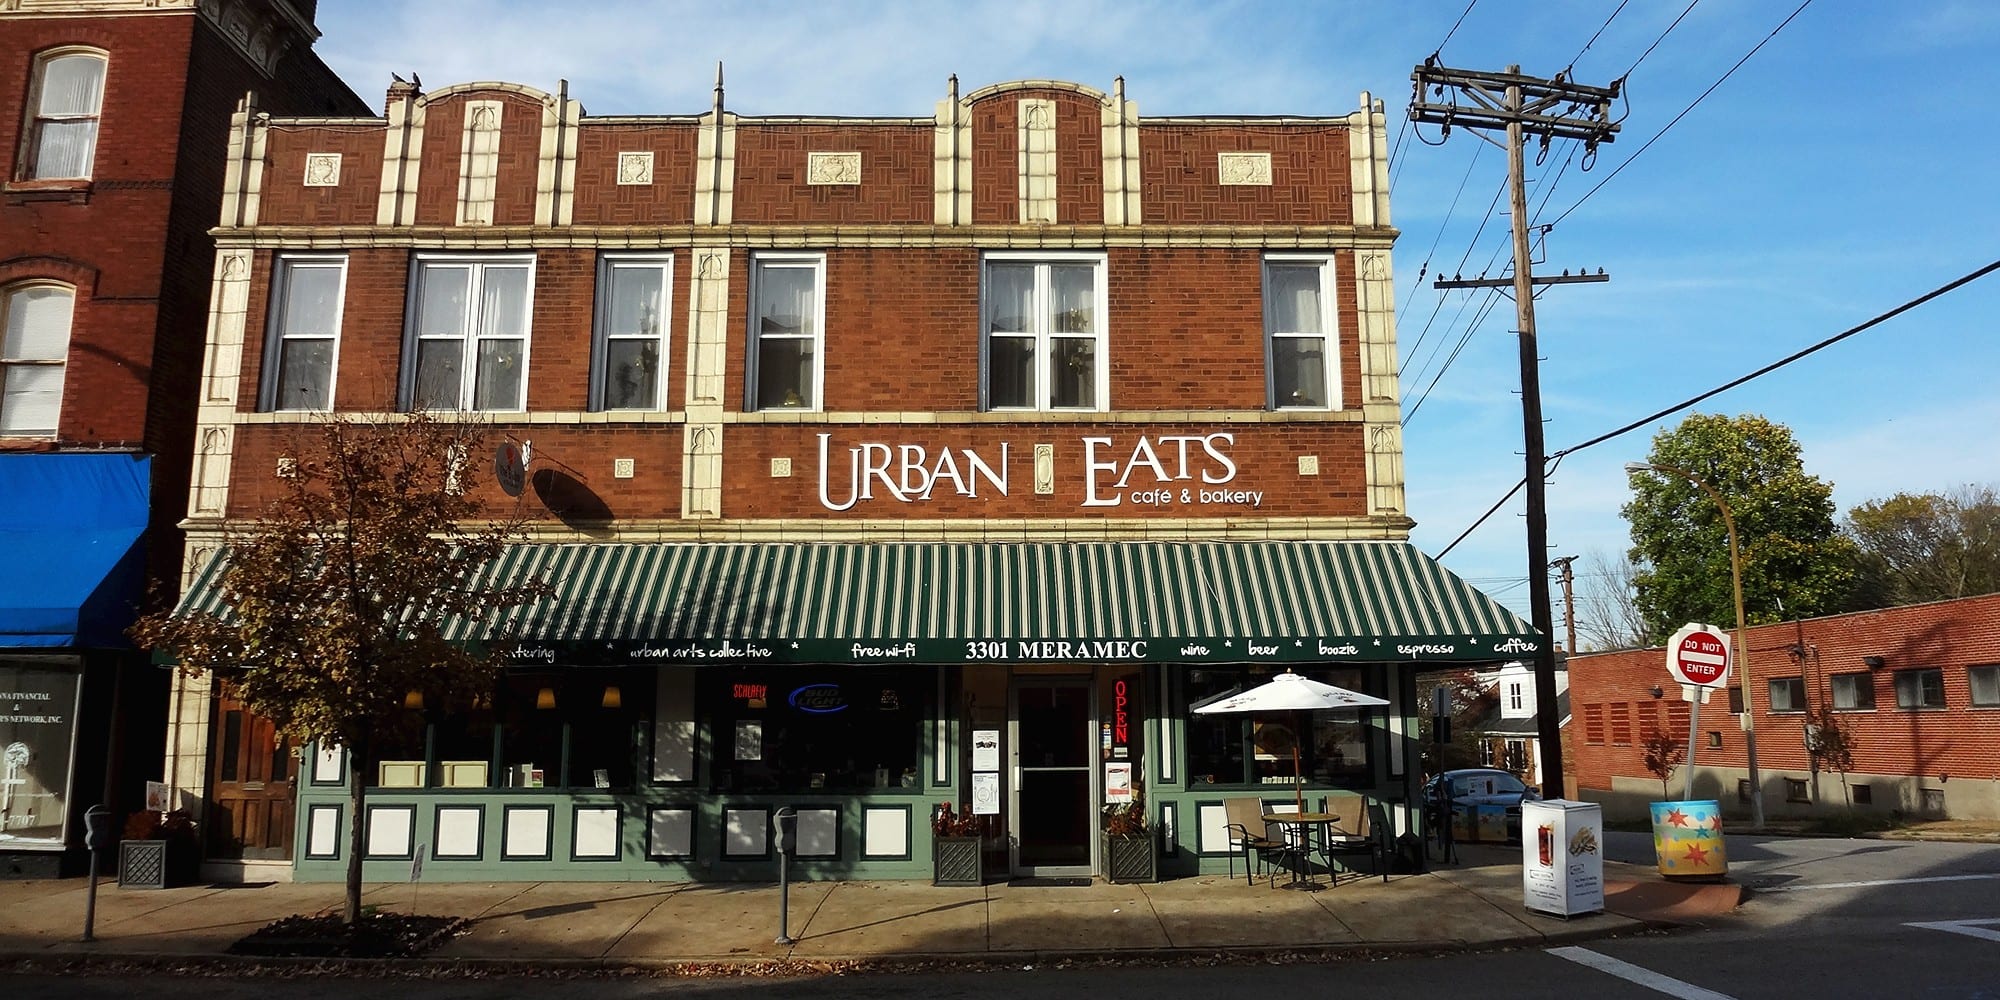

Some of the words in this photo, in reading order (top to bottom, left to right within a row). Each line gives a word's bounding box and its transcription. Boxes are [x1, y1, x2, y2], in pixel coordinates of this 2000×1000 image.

[816, 433, 1009, 511] URBAN
[1080, 432, 1237, 507] EATS
[1131, 488, 1172, 507] café
[1179, 488, 1192, 504] &
[1199, 488, 1263, 507] bakery
[506, 643, 555, 664] tering
[630, 642, 669, 658] urban
[673, 643, 706, 658] arts
[709, 640, 772, 658] collective
[851, 642, 885, 659] free
[885, 642, 917, 658] wi-fi
[965, 641, 1009, 659] 3301
[1017, 641, 1147, 659] MERAMEC
[1180, 643, 1210, 656] wine
[1248, 640, 1279, 656] beer
[1318, 639, 1359, 656] boozie
[1397, 644, 1454, 659] espresso
[1493, 638, 1538, 653] coffee
[1684, 639, 1698, 650] DO
[1702, 642, 1721, 653] NOT
[1686, 664, 1716, 675] ENTER
[12, 692, 51, 701] FINANCIAL
[733, 683, 767, 699] SCHLAFLY
[805, 688, 839, 697] BUD
[798, 696, 843, 705] LIGHT
[1115, 681, 1128, 743] OPEN
